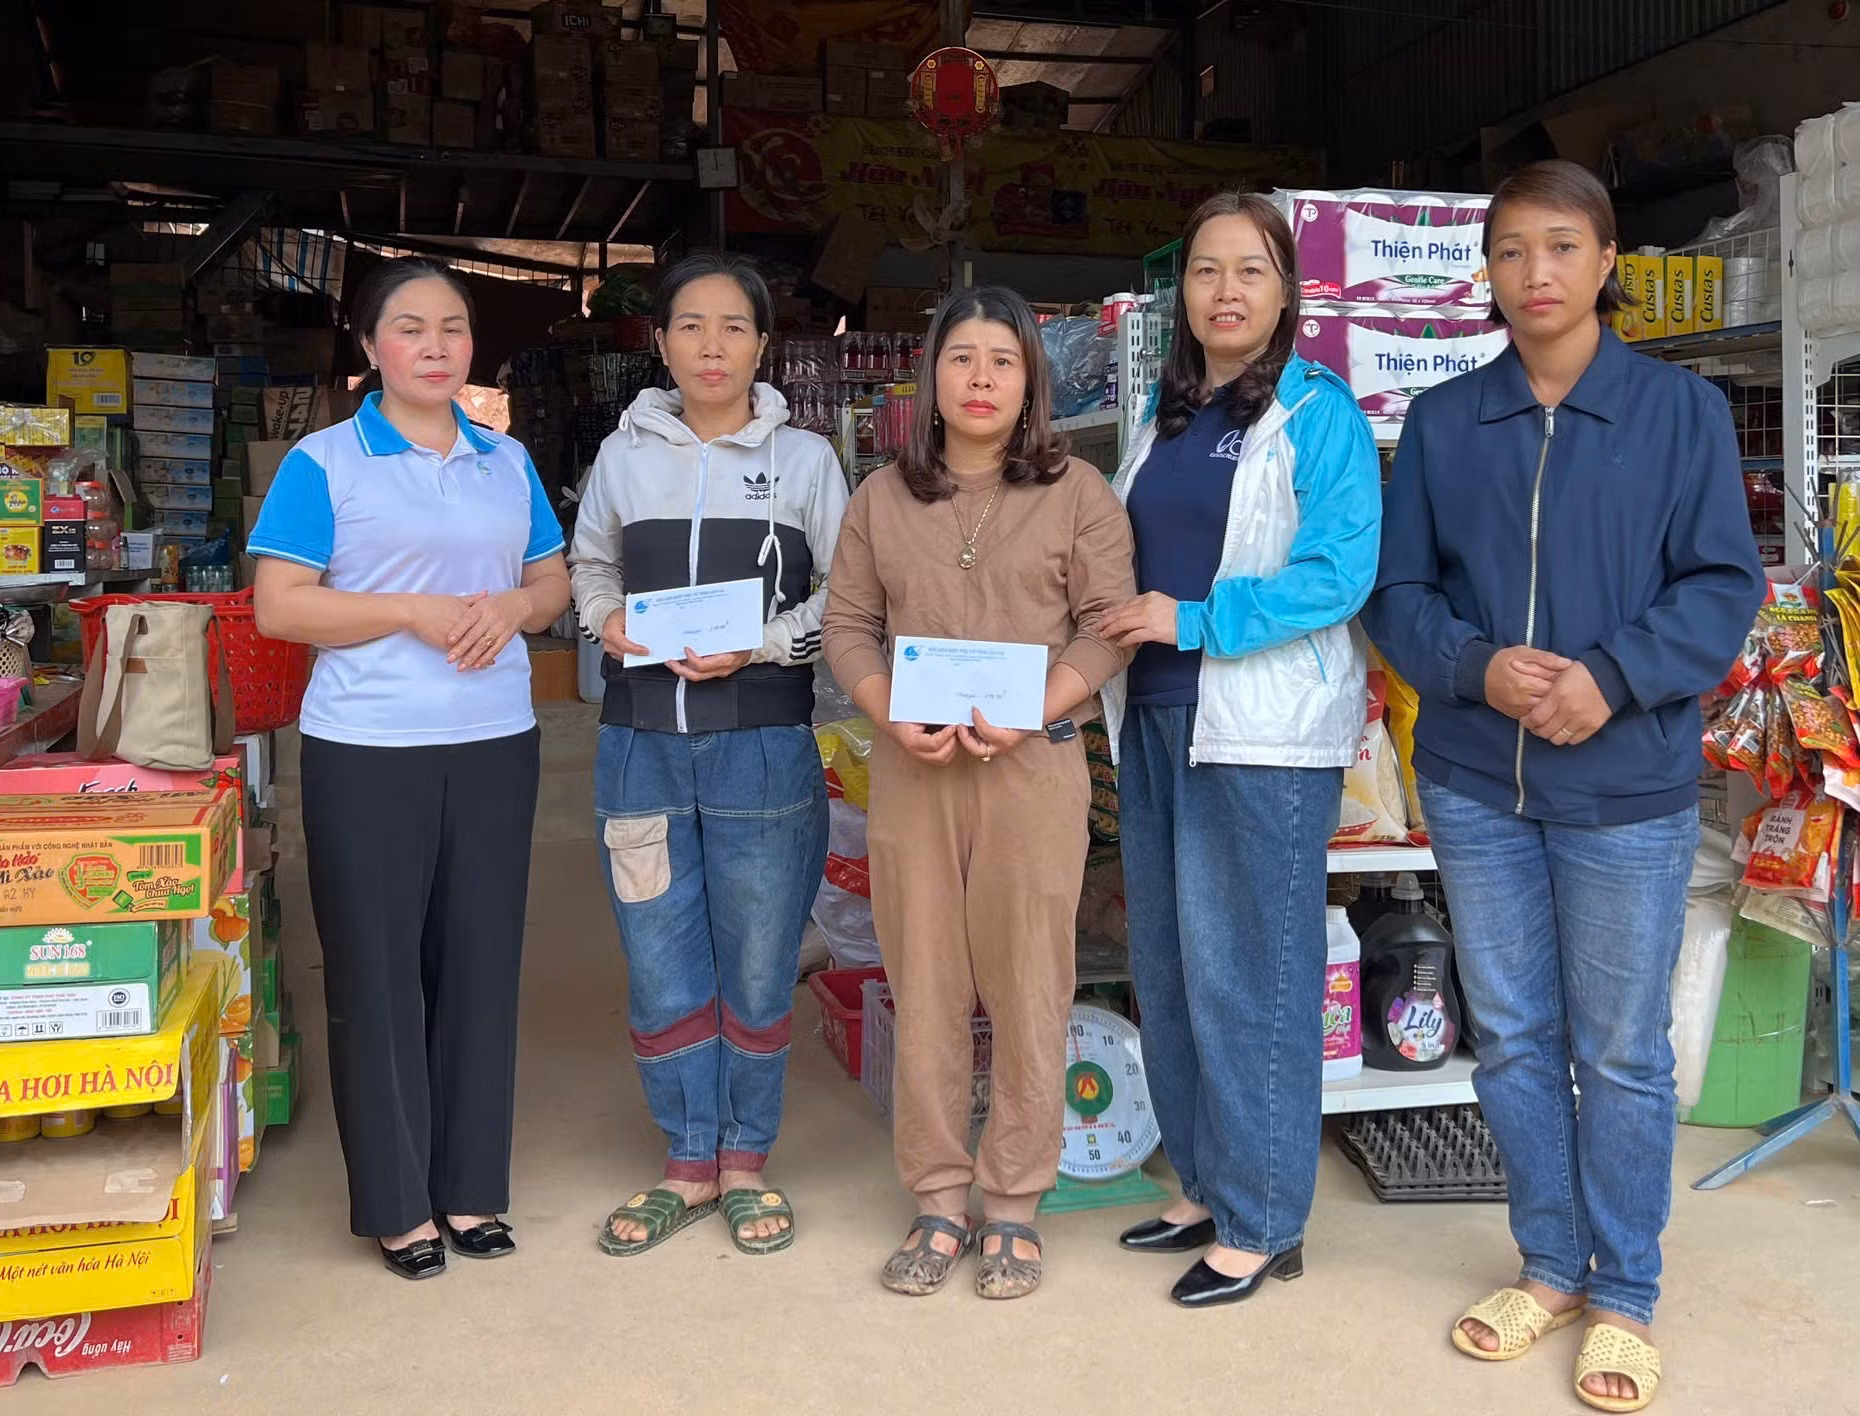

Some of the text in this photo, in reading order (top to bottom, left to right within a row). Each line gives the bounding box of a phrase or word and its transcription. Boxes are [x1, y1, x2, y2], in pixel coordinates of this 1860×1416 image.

[1371, 239, 1471, 263] Thiện Phát
[1405, 275, 1445, 284] Gentle Care
[1643, 269, 1656, 323] Custas
[1671, 269, 1684, 323] Custas
[1700, 269, 1714, 323] Custas
[1375, 353, 1477, 375] Thiện Phát
[1770, 814, 1792, 825] BÁNH
[1404, 1005, 1442, 1038] Lily
[1102, 1035, 1114, 1046] 10
[1125, 1063, 1138, 1076] 20
[20, 1073, 73, 1101] HƠI
[79, 1064, 118, 1094] HÀ
[124, 1061, 174, 1094] NỘI
[1134, 1101, 1146, 1112] 30
[1117, 1130, 1132, 1144] 40
[1088, 1149, 1101, 1161] 50
[0, 1250, 152, 1283] Một nét văn hóa Hà Nội
[110, 1339, 132, 1354] Hãy
